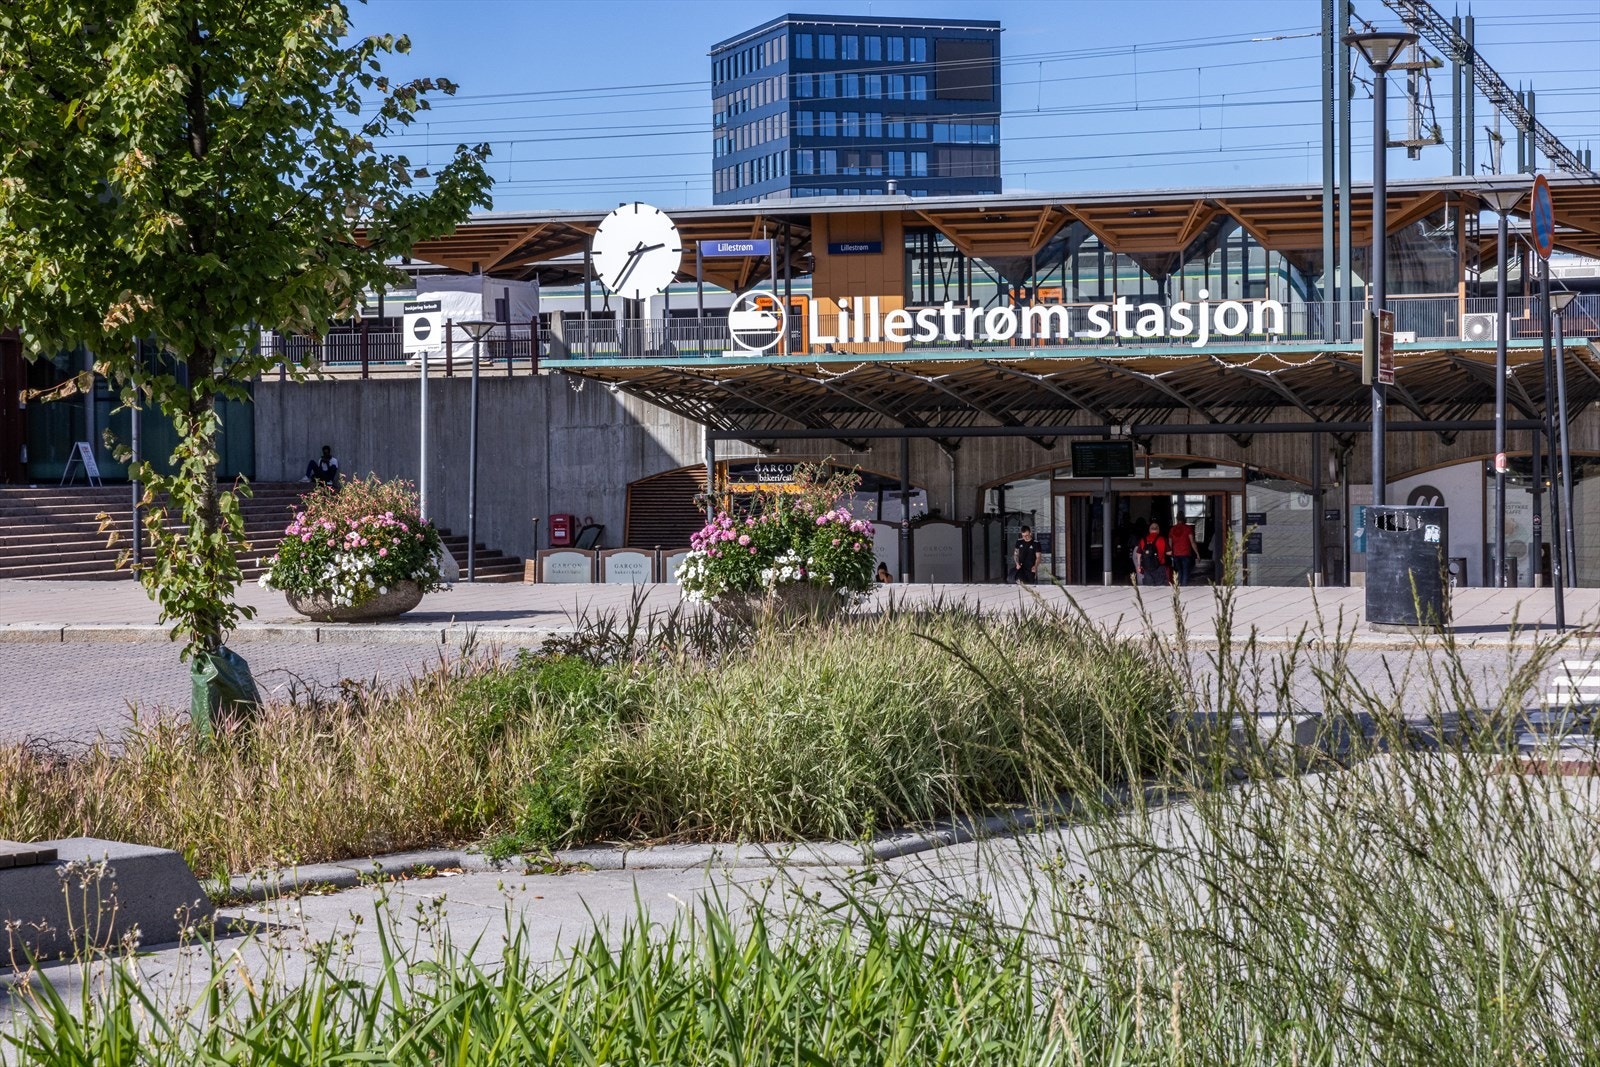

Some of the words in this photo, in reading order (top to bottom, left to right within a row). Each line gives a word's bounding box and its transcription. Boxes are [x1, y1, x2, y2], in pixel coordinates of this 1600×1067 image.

[717, 242, 754, 252] Lillestrøm
[809, 296, 1069, 344] Lillestrøm
[1086, 288, 1285, 348] stasjon
[754, 464, 795, 474] GARÇO
